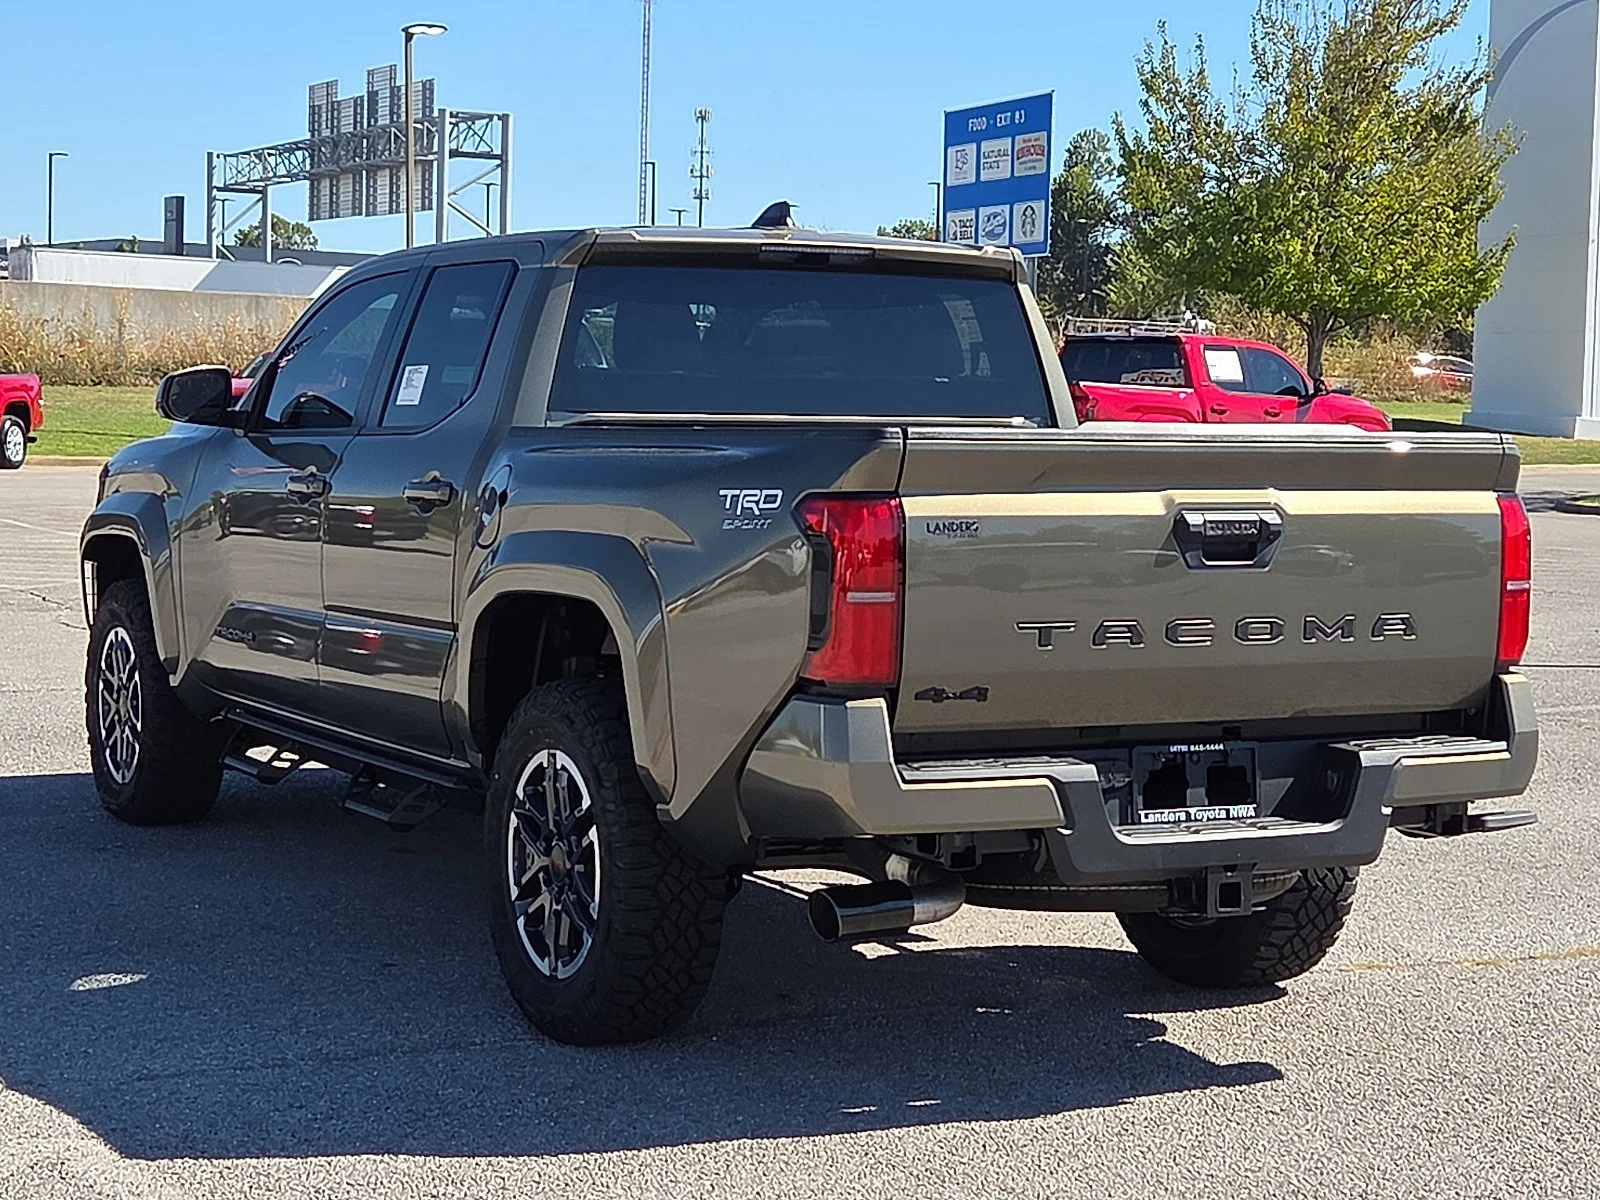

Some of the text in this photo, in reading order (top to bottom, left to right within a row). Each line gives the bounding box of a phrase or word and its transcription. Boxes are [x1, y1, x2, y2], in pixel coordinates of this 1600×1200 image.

[968, 116, 987, 132] FOOD
[996, 112, 1011, 127] EXIT
[982, 148, 1010, 160] NATURAL
[982, 160, 1000, 171] STATE
[958, 218, 974, 229] TACO
[959, 229, 974, 241] BELL
[719, 489, 783, 516] TRD
[722, 519, 772, 529] SPORT
[926, 520, 979, 535] LANDERS
[1014, 612, 1418, 651] TACOMA
[1140, 806, 1256, 823] Landers Toyota NWA
